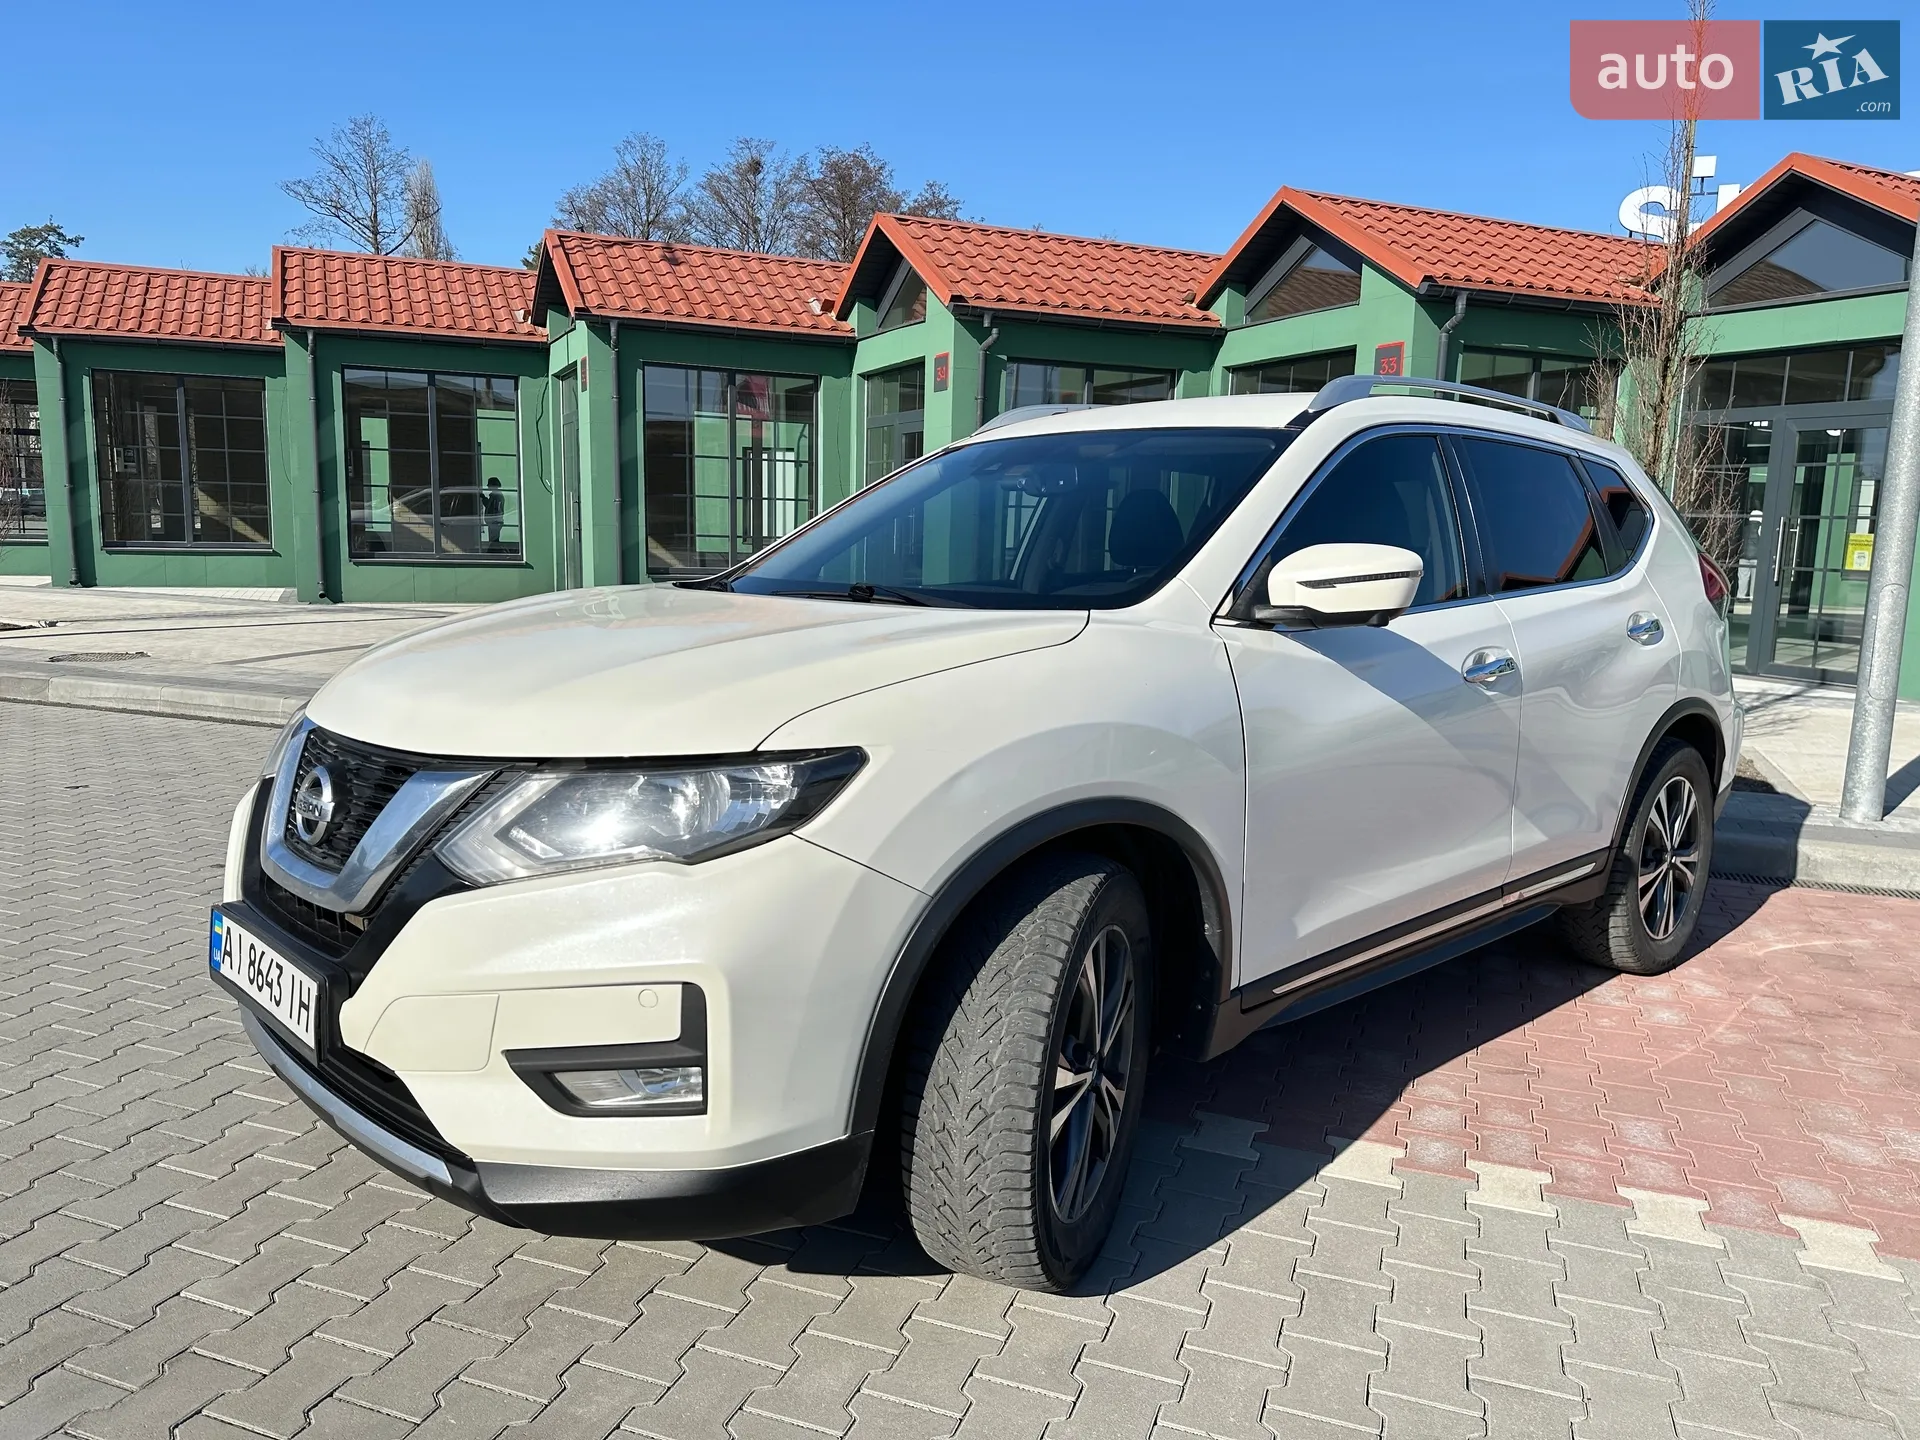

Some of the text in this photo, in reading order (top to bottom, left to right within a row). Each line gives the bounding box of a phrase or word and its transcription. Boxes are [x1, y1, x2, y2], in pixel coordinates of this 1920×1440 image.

[1380, 357, 1397, 374] 33
[221, 926, 311, 1034] AI 8643 IH
